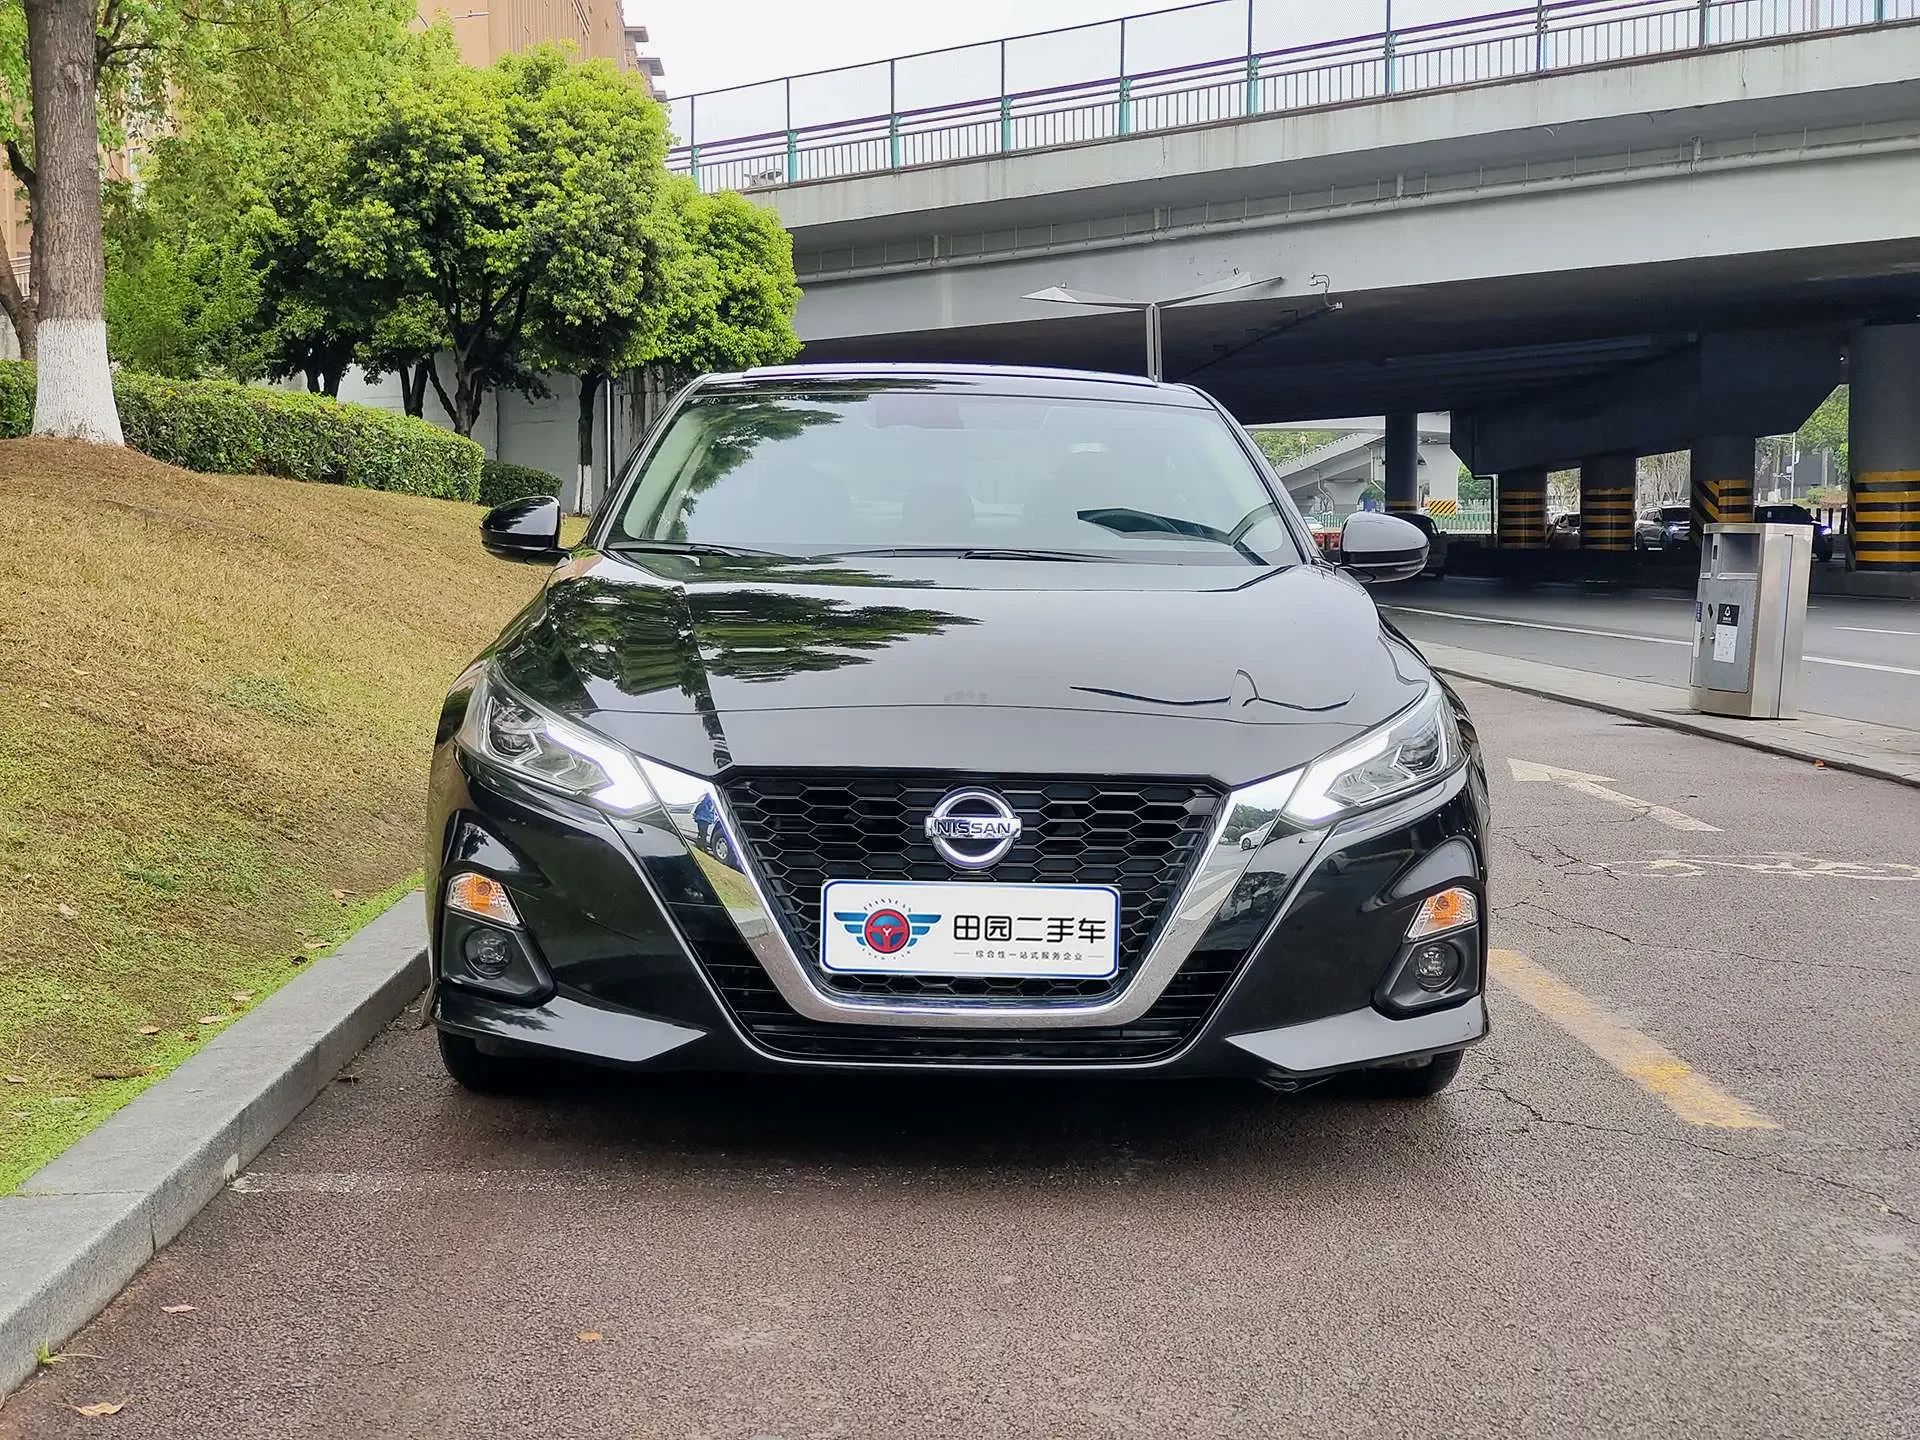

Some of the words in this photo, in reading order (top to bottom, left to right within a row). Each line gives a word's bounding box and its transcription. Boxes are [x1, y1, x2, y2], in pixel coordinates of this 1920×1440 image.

[936, 821, 1011, 835] NISSAN
[953, 914, 1107, 944] 田园二手车
[975, 950, 1083, 961] 综合性一站式服务企业
